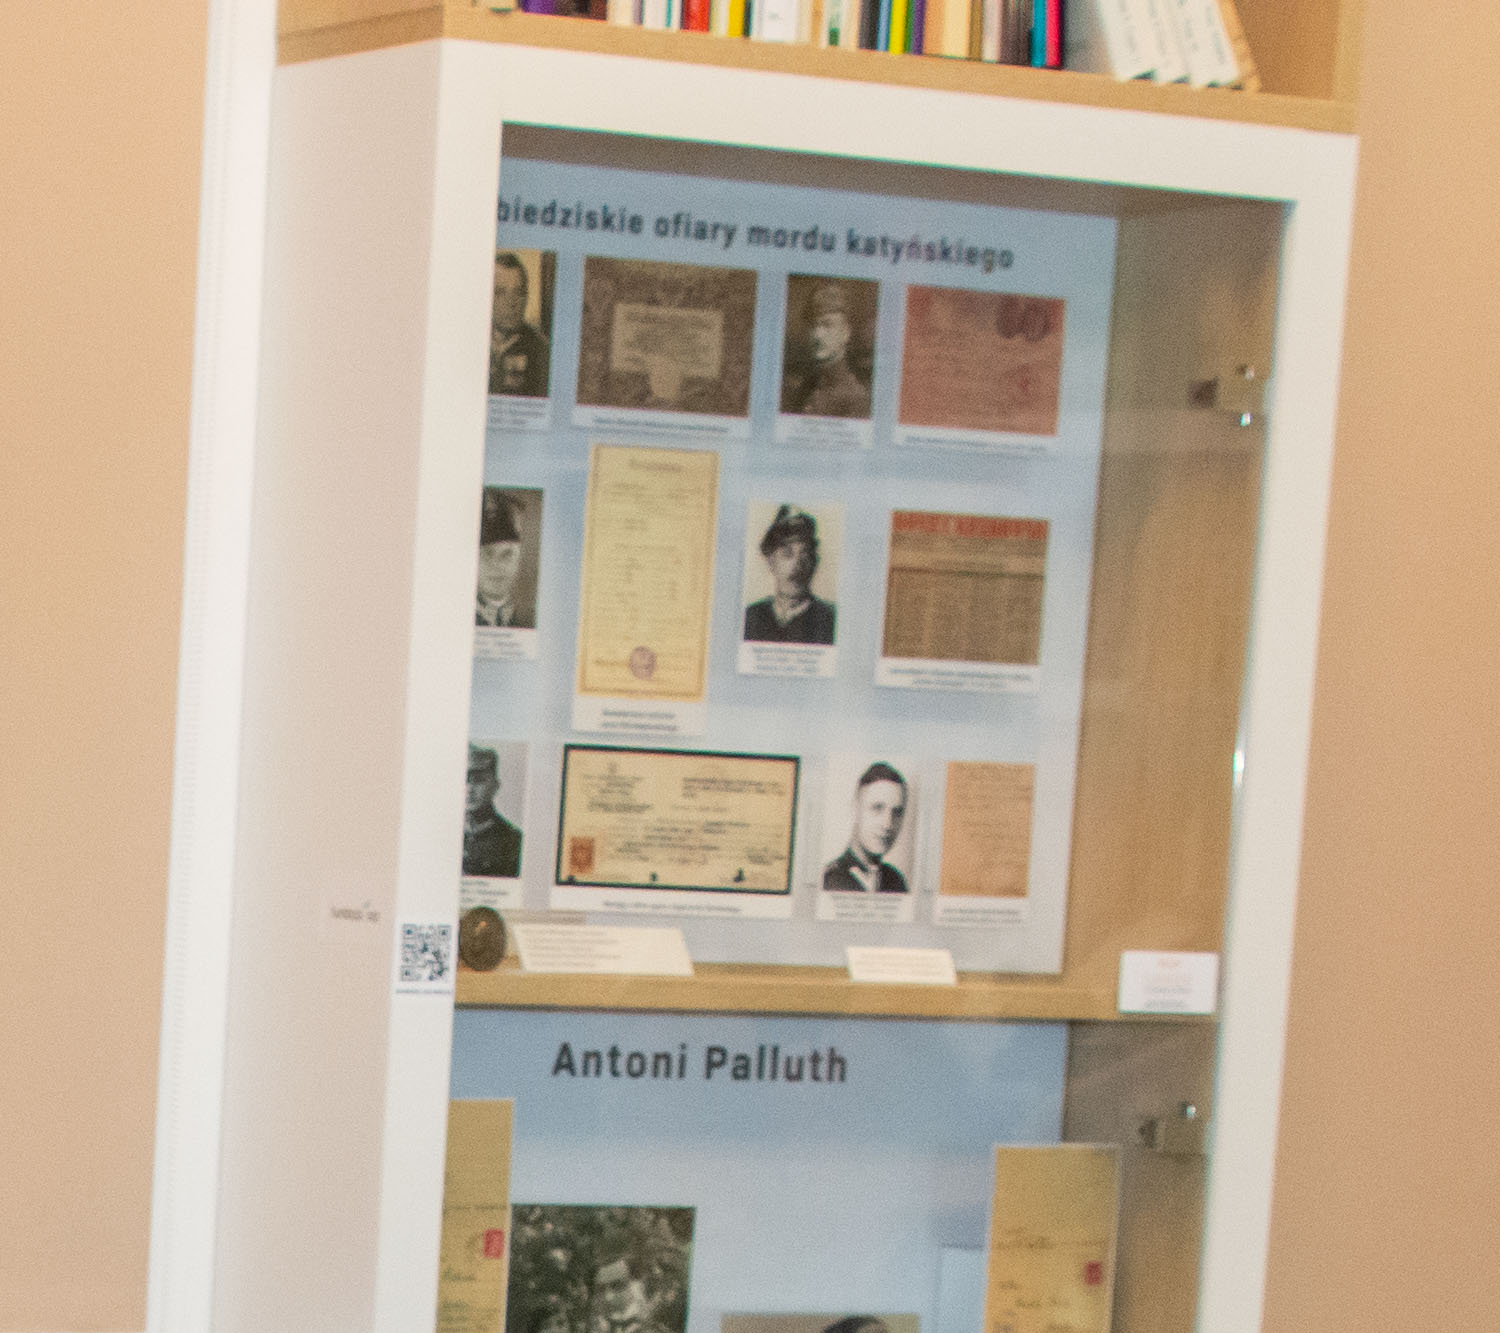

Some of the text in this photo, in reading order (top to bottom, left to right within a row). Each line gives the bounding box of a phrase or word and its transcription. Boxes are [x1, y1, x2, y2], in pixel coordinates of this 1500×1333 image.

[654, 215, 738, 250] ofiary
[746, 223, 836, 254] mordu
[845, 228, 1015, 275] katyńskiego
[551, 1041, 850, 1084] Antoni Palluth
